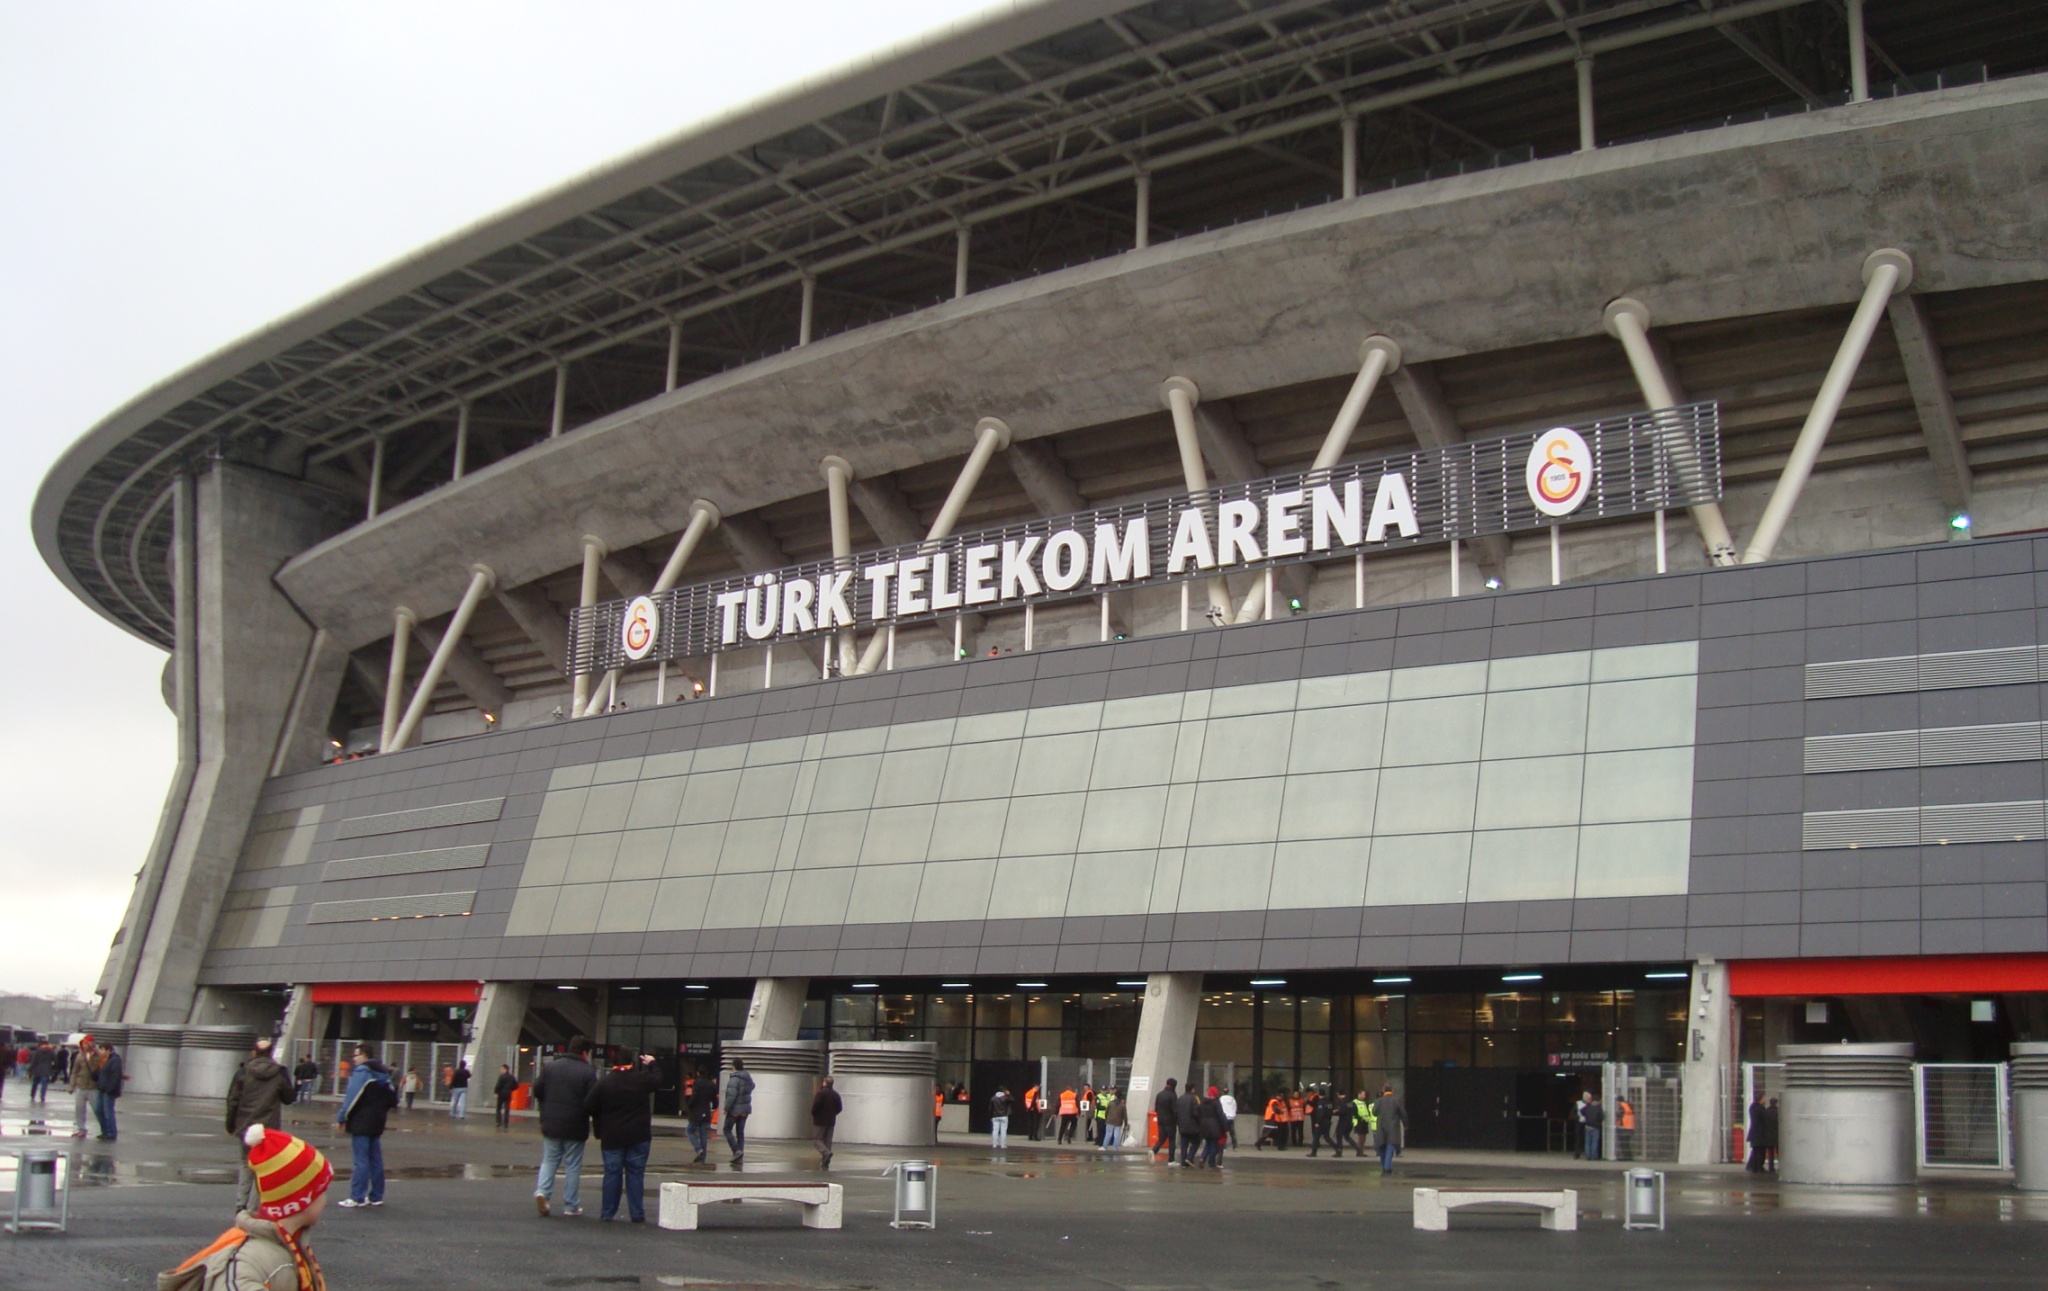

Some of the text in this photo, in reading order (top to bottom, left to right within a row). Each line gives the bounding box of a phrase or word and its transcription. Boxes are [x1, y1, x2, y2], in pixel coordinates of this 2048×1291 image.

[715, 473, 1420, 645] TÜRK TELEKOM ARENA
